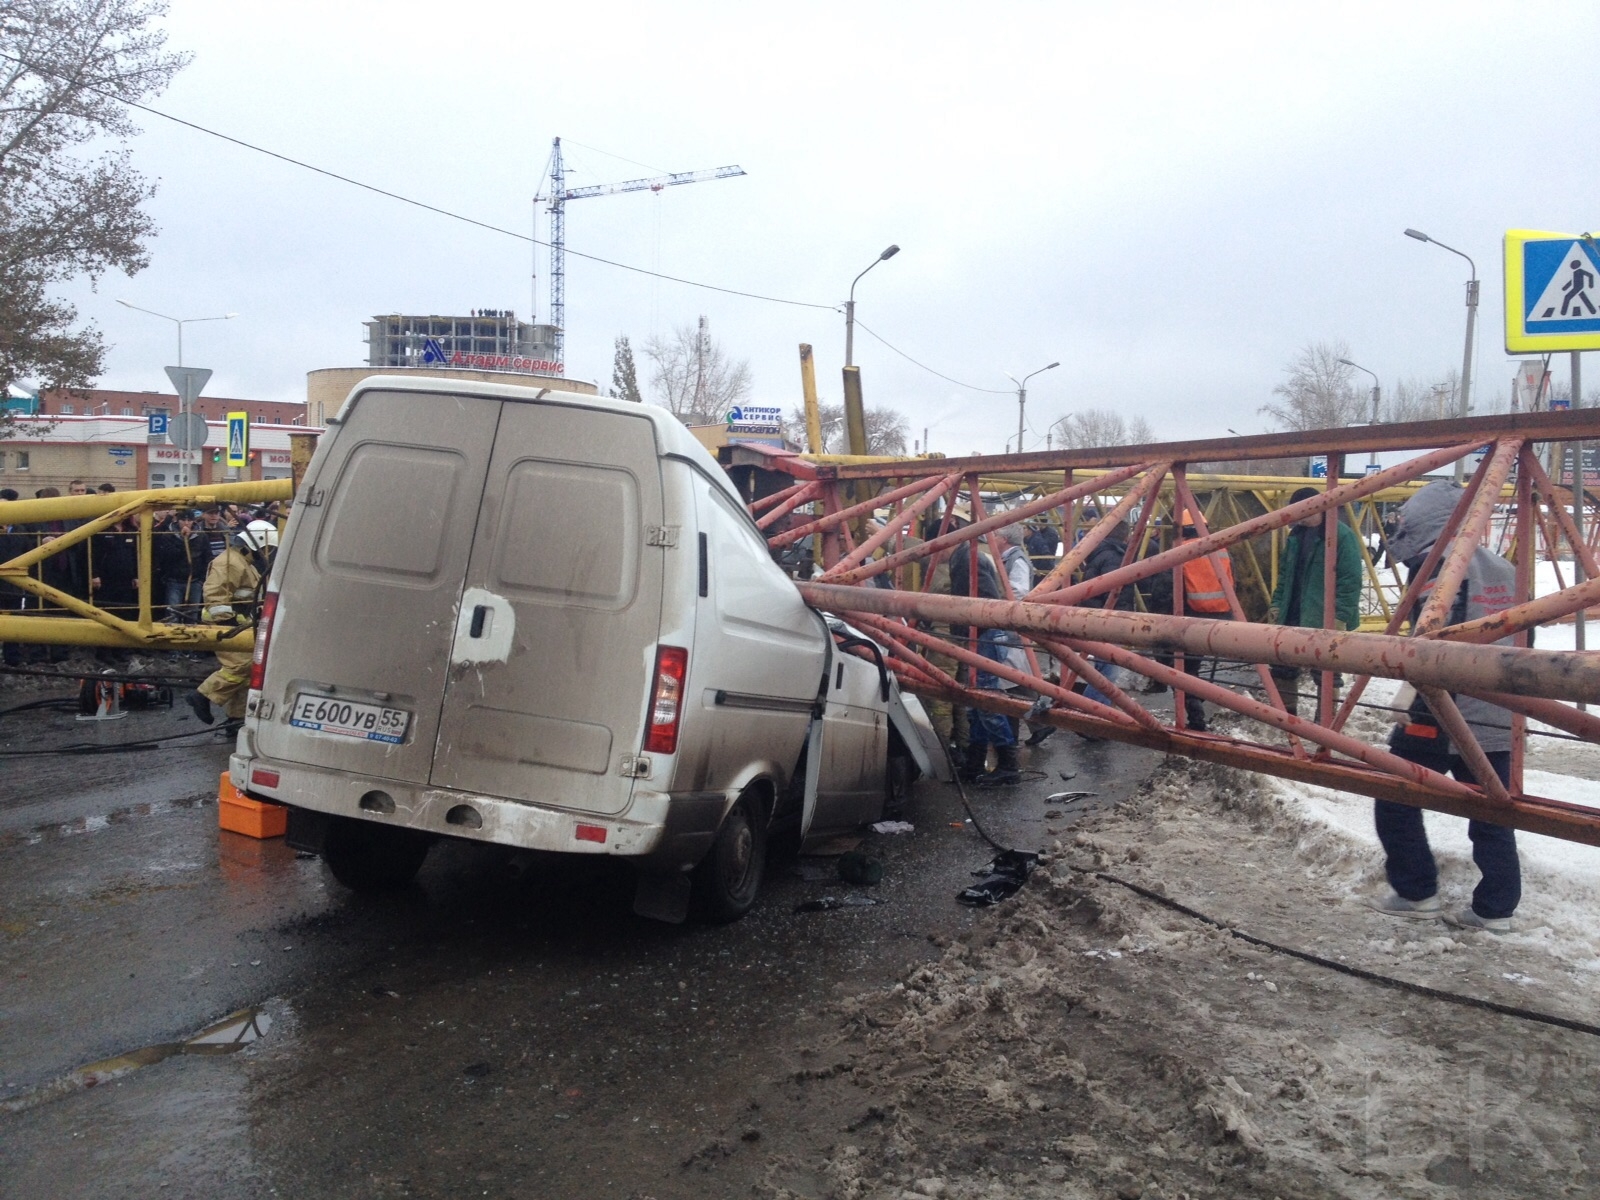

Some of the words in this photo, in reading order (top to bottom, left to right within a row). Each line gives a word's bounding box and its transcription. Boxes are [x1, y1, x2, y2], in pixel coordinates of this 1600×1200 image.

[513, 356, 565, 373] сервис
[743, 406, 781, 414] АНТИКОР
[743, 413, 781, 421] СЕРВИС
[302, 701, 377, 729] Е600УВ
[381, 709, 402, 728] 55
[376, 725, 393, 734] RUS
